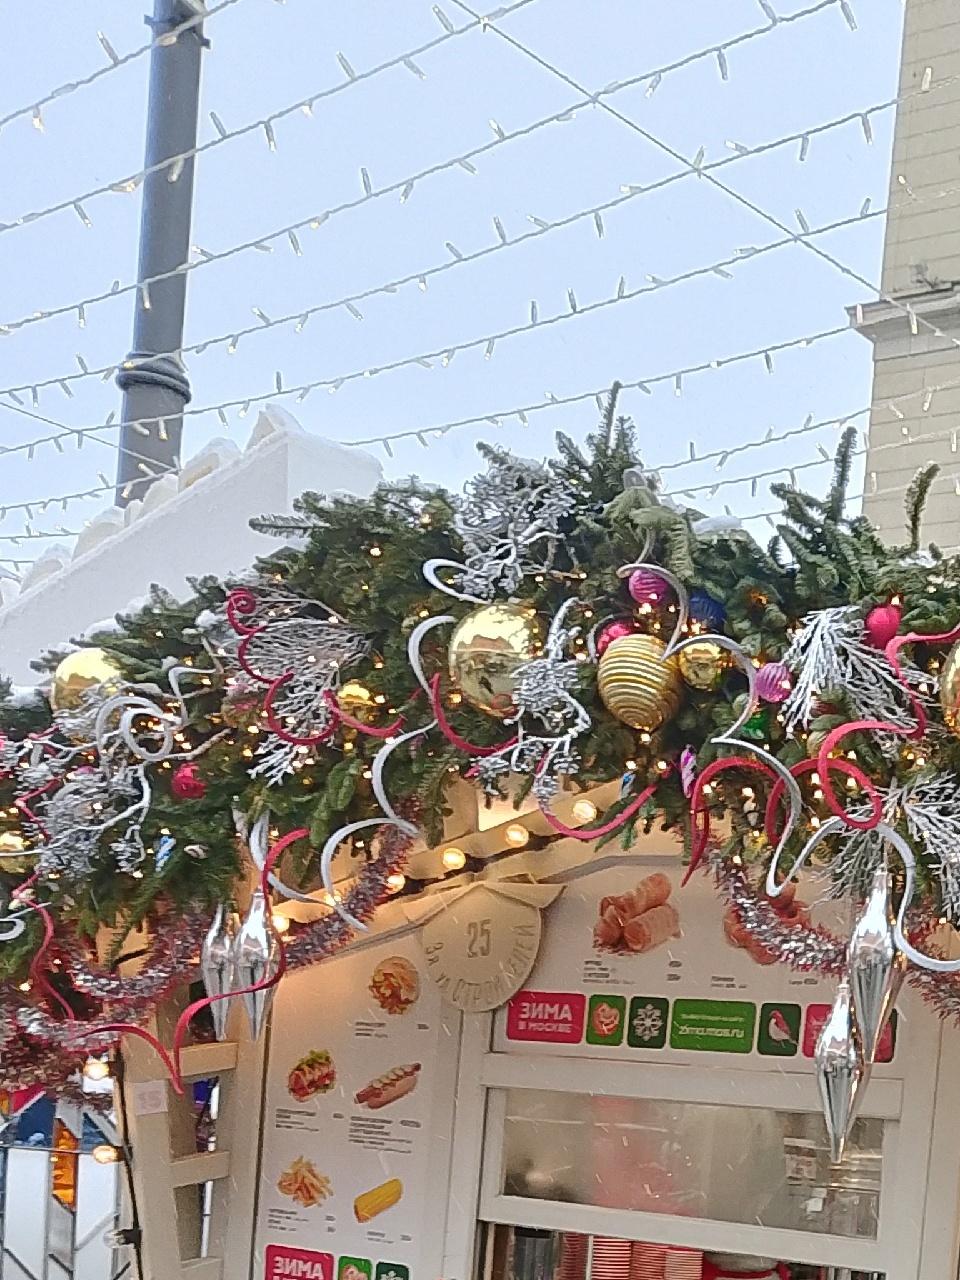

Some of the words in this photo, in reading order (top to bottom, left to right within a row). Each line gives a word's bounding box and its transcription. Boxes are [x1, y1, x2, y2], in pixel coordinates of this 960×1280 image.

[519, 1002, 572, 1021] ЗИМА
[528, 1022, 573, 1033] МОСКВЕ
[272, 1256, 324, 1280] ЗИМА
